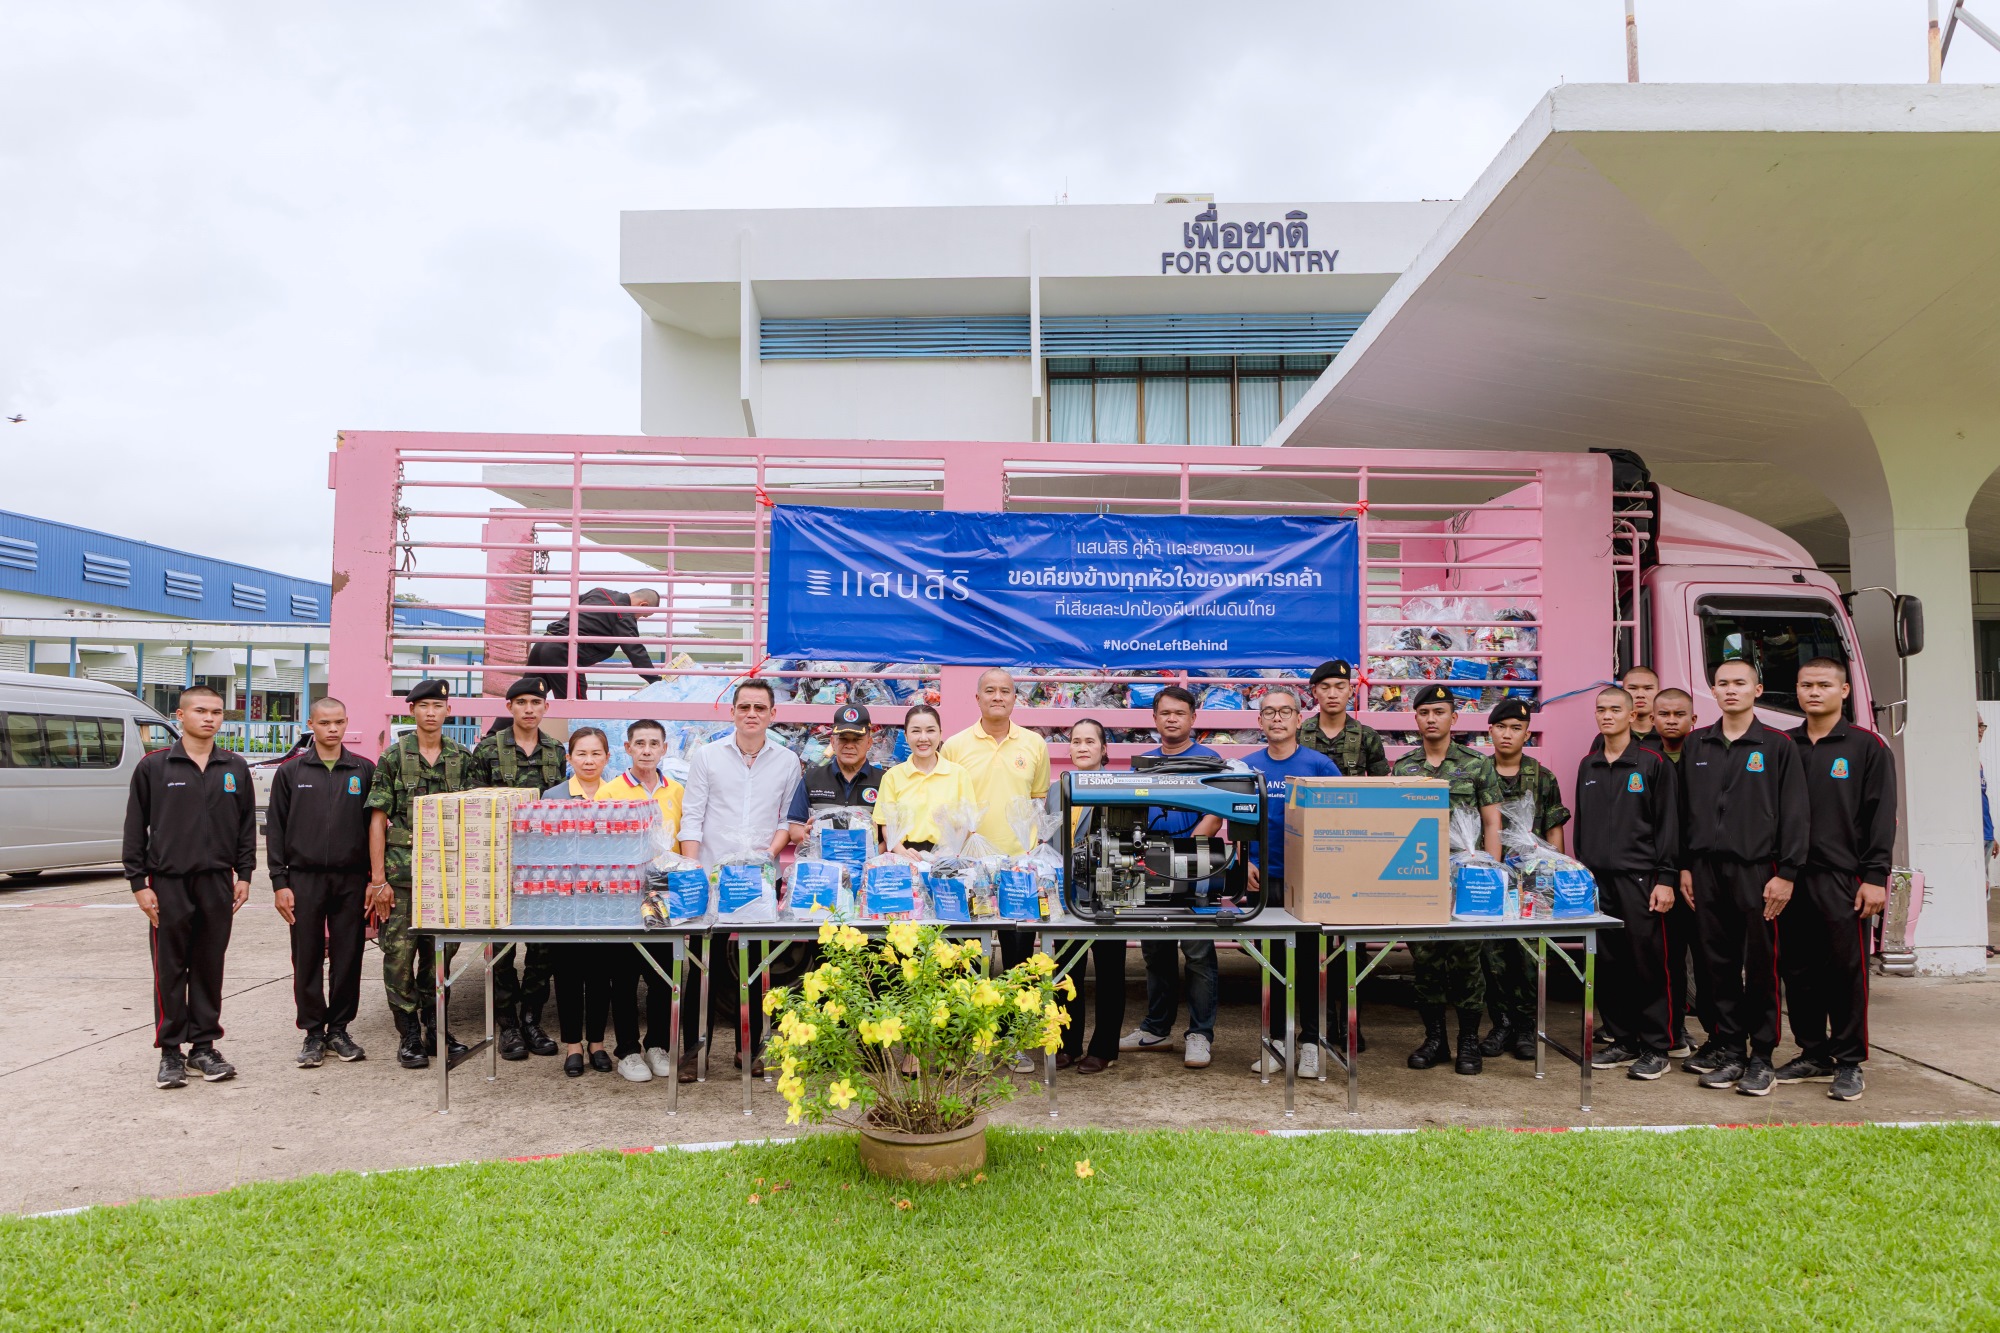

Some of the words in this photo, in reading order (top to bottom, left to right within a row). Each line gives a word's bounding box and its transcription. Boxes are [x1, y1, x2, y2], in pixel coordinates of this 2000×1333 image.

[1183, 203, 1309, 249] เพื่อชาติ
[1162, 251, 1211, 274] FOR
[1217, 250, 1340, 274] COUNTRY
[1077, 540, 1128, 555] แสนสิริ
[1132, 538, 1161, 560] คู่ค้า
[1167, 543, 1254, 556] และยงสงวน
[842, 569, 970, 601] แสนสิริ
[1008, 565, 1322, 593] ขอเคียงข้างทุกหัวใจของทหารกล้า
[1055, 596, 1276, 617] ที่เสียสละปกป้องผืนแผ่นดินไทย
[1103, 639, 1228, 651] #NoOneLeftBehind
[1089, 777, 1114, 785] SDMO
[1415, 842, 1428, 864] 5
[1397, 865, 1431, 875] cc/mL
